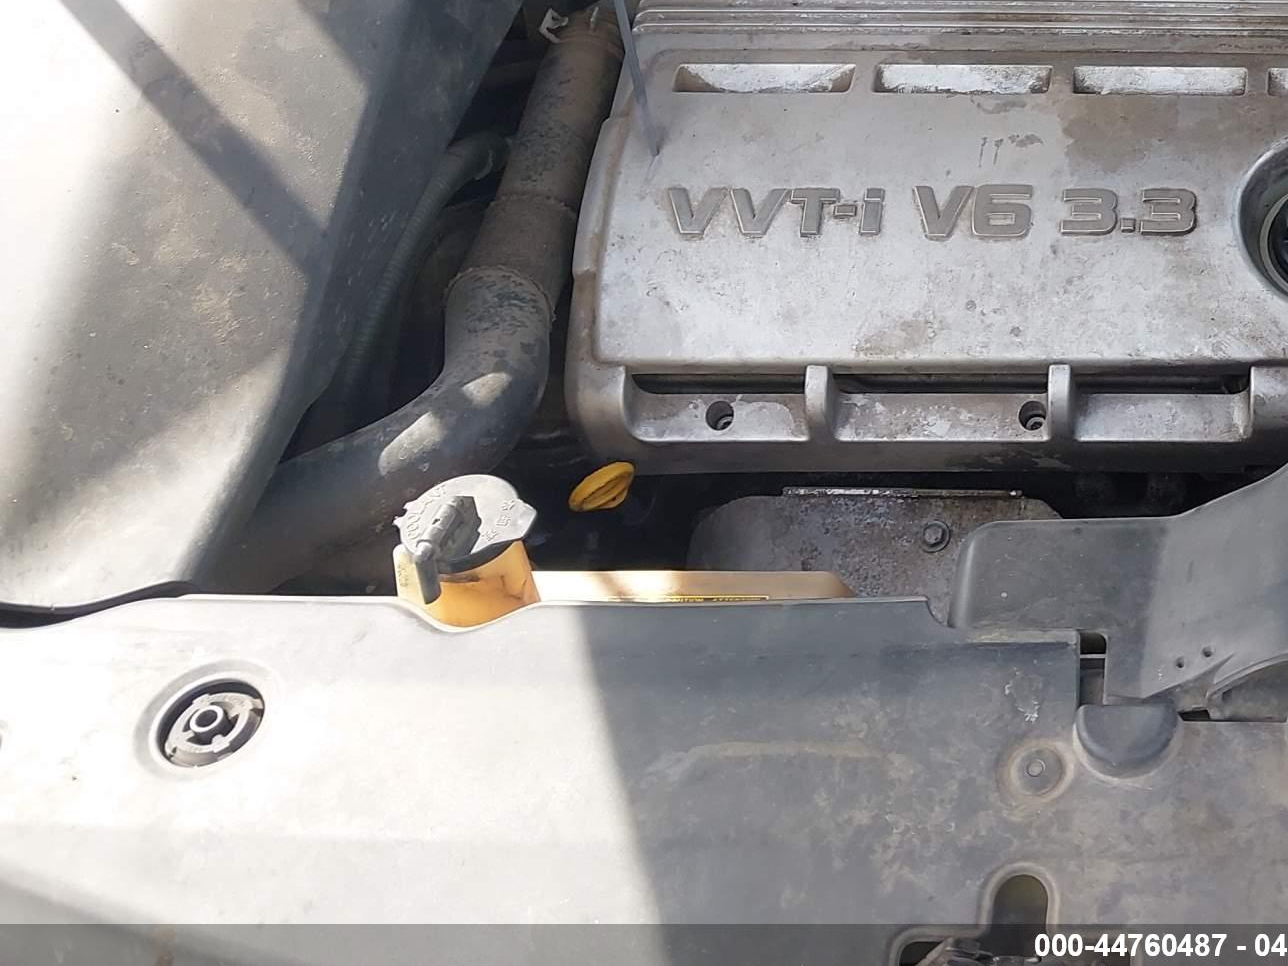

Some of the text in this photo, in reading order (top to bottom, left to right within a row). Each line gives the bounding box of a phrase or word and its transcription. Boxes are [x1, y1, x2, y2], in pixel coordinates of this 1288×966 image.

[667, 183, 1198, 238] VVT-i V6 3.3
